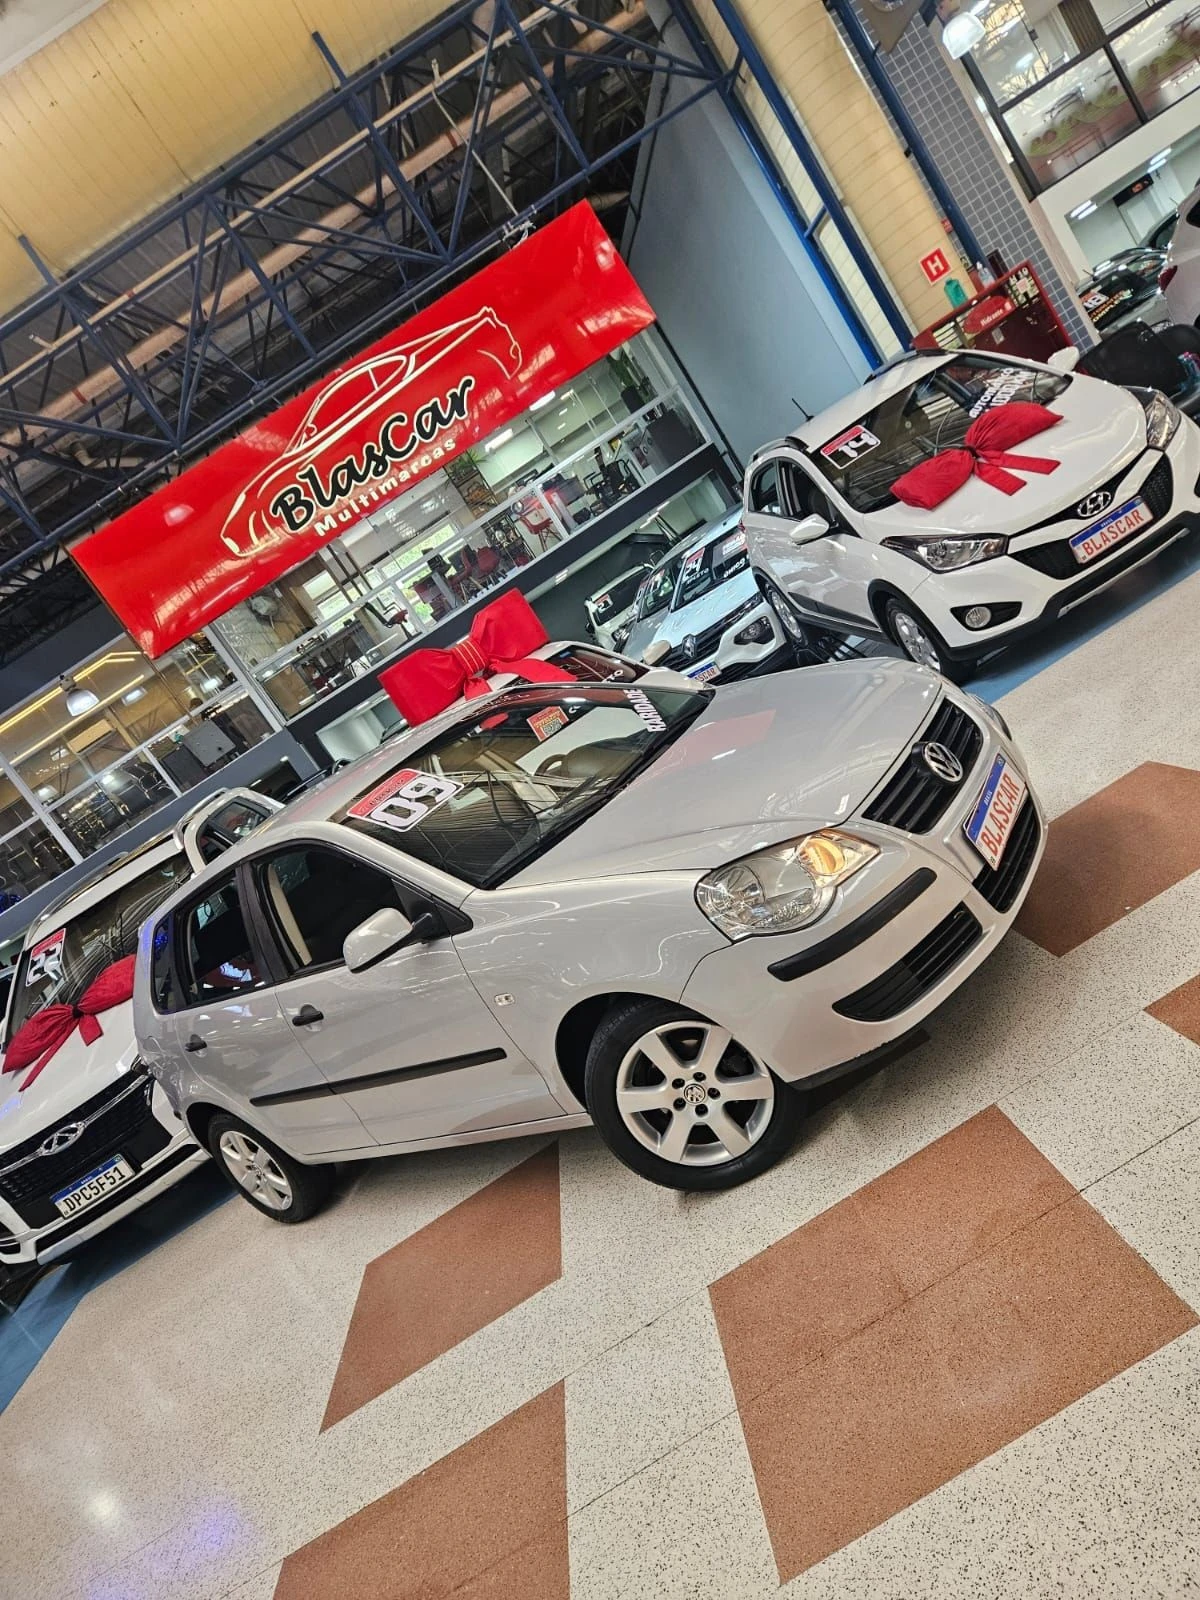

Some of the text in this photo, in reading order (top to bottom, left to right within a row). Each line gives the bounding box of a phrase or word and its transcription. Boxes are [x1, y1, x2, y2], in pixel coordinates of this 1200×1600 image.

[927, 254, 945, 276] H
[270, 375, 476, 532] BlasCar
[838, 432, 877, 458] 14
[313, 438, 457, 537] Multimarcas
[1082, 508, 1144, 557] BLASCAR
[623, 688, 668, 733] RARIDADE
[370, 774, 457, 827] 09
[981, 773, 1020, 856] BLASCAR
[62, 1166, 126, 1212] DPC5F51
